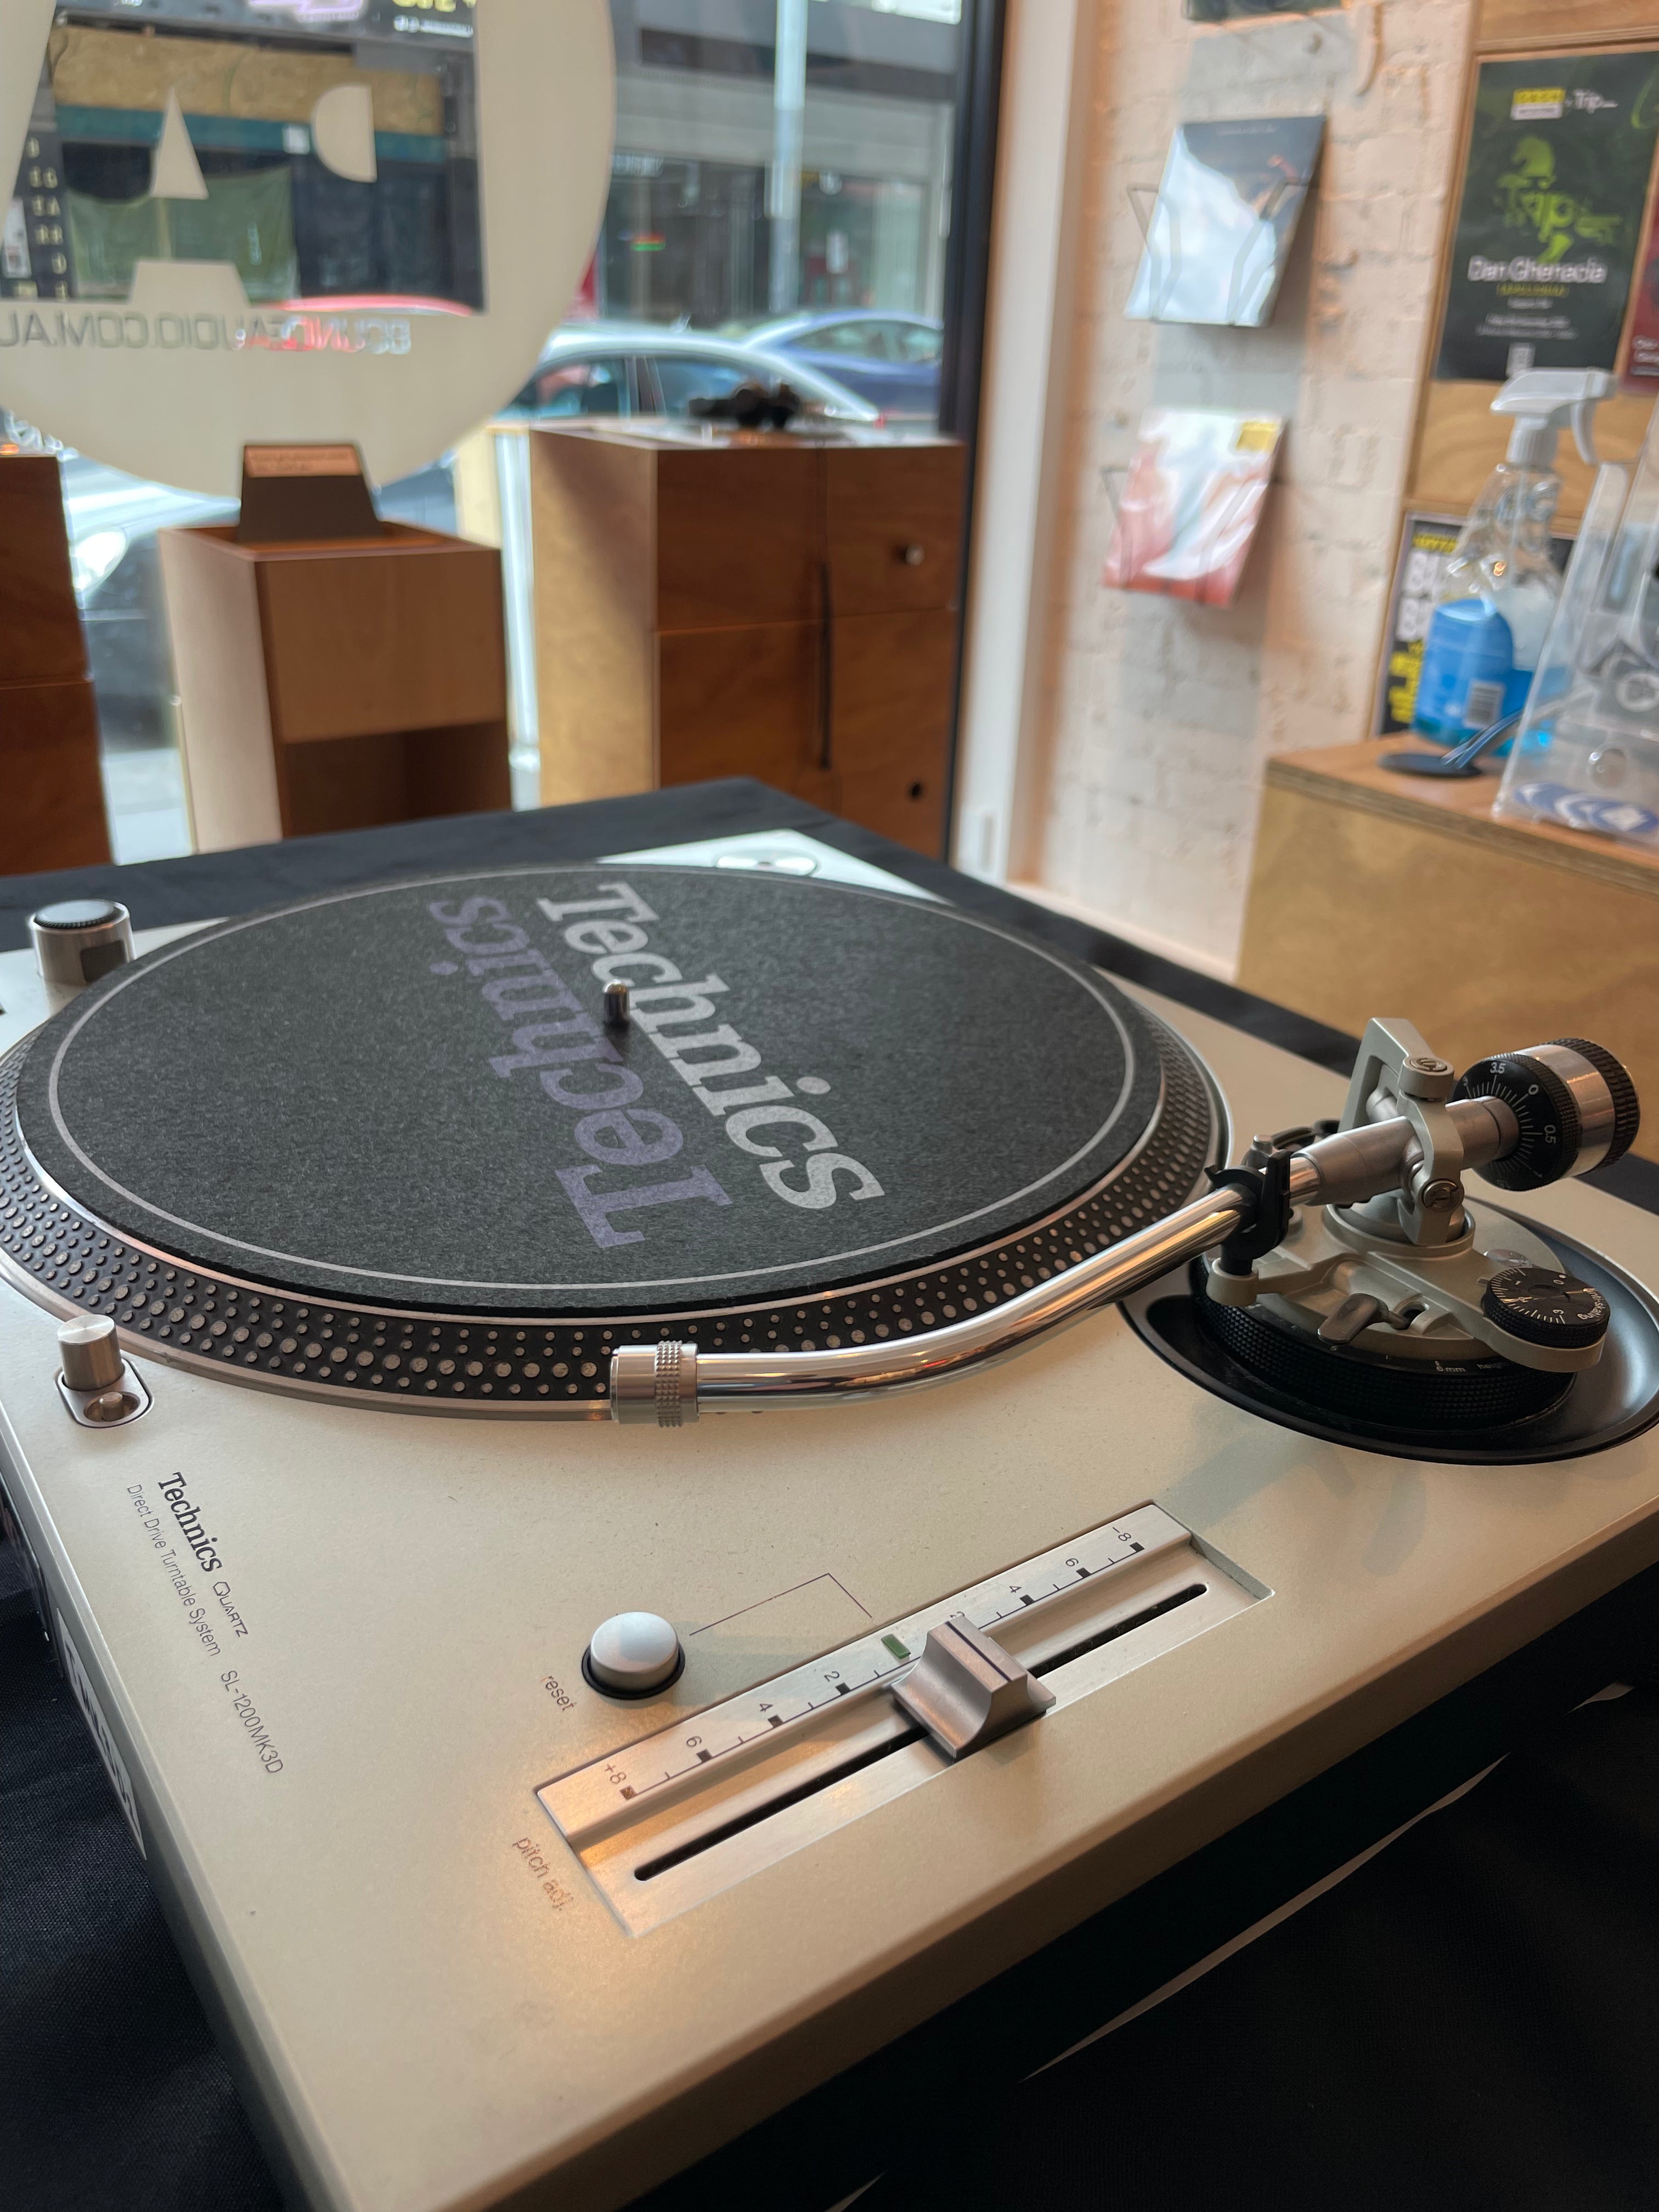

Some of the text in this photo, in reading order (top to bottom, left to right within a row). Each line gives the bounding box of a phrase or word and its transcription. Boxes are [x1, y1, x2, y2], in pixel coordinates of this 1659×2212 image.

[538, 882, 884, 1208] Technics
[429, 896, 733, 1248] Technics
[1489, 1062, 1506, 1074] 3.5
[1528, 1084, 1539, 1095] 0
[1544, 1125, 1557, 1144] 0.5
[157, 1471, 249, 1638] Technics QUARTZ
[1065, 1558, 1079, 1567] 6
[1009, 1585, 1022, 1593] 4
[127, 1483, 284, 1774] Direct Drive Turntable System SL-1200MK3D
[823, 1671, 840, 1682] 2
[540, 1675, 577, 1711] reset
[759, 1702, 774, 1712] 4
[686, 1735, 702, 1748] 6
[603, 1763, 627, 1785] +8
[512, 1837, 574, 1911] pitch adj.
